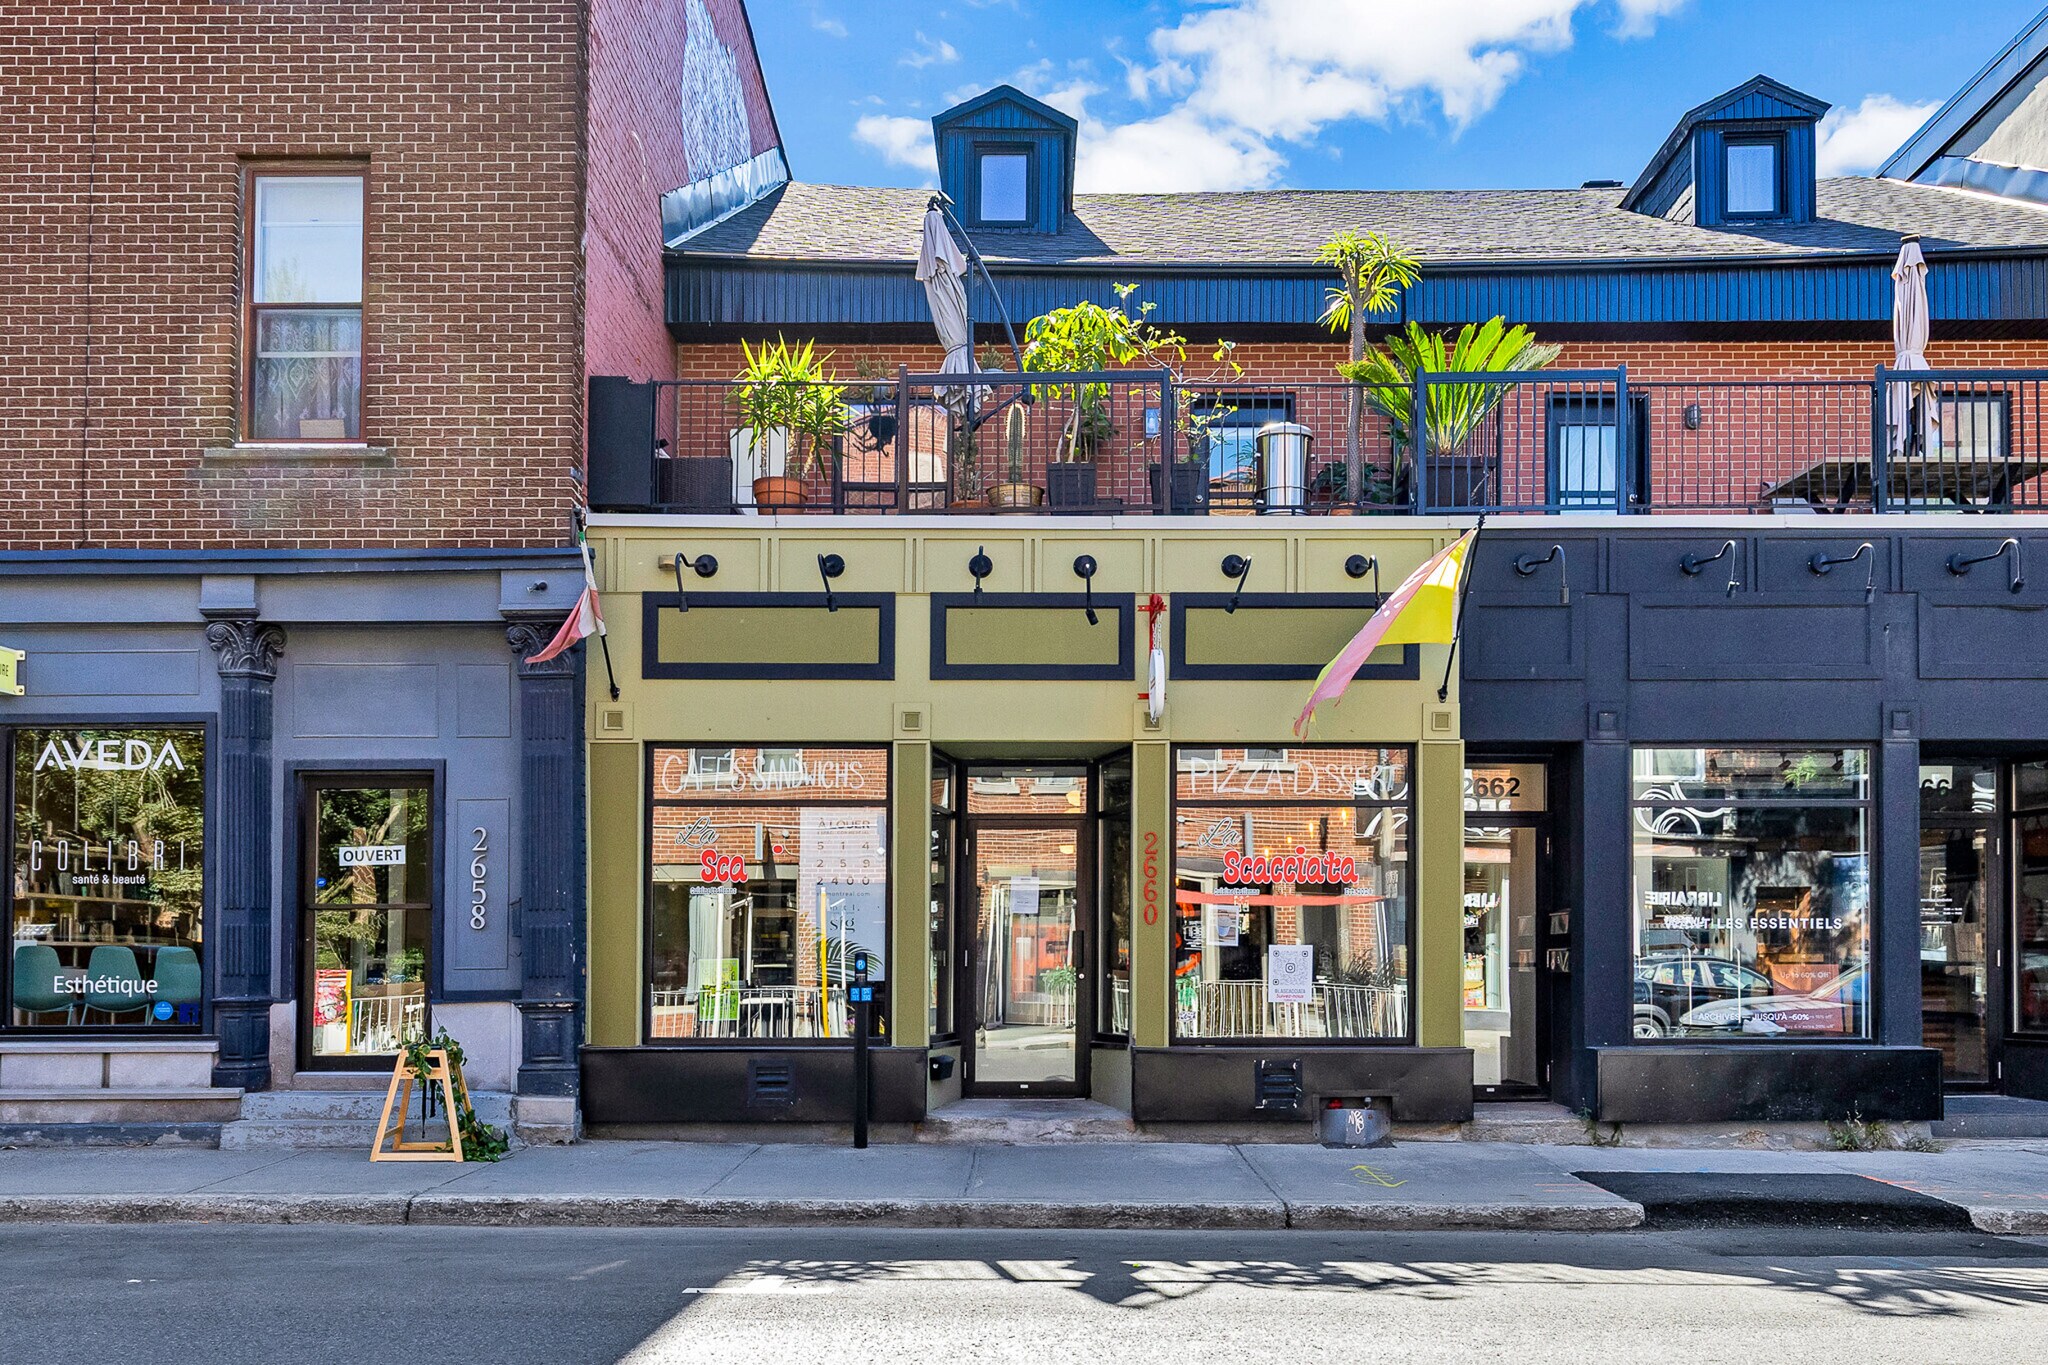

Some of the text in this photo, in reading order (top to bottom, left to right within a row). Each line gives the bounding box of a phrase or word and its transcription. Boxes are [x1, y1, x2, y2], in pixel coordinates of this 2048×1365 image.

[34, 739, 185, 771] AVEDA
[1464, 777, 1520, 797] 2662
[675, 816, 720, 848] La
[1198, 816, 1243, 849] La
[31, 840, 184, 871] COLIBRI
[343, 849, 402, 862] OUVERT
[700, 849, 749, 883] Sca
[1223, 846, 1359, 885] Scacciata
[72, 874, 146, 885] santé & beauté
[469, 826, 488, 930] 2658
[1143, 831, 1158, 926] 2660
[1717, 918, 1744, 929] LES
[1750, 918, 1843, 929] ESSENTIELS
[53, 974, 159, 998] Esthétique
[1698, 1013, 1739, 1021] ARCHIVES
[1789, 1013, 1810, 1021] -60%
